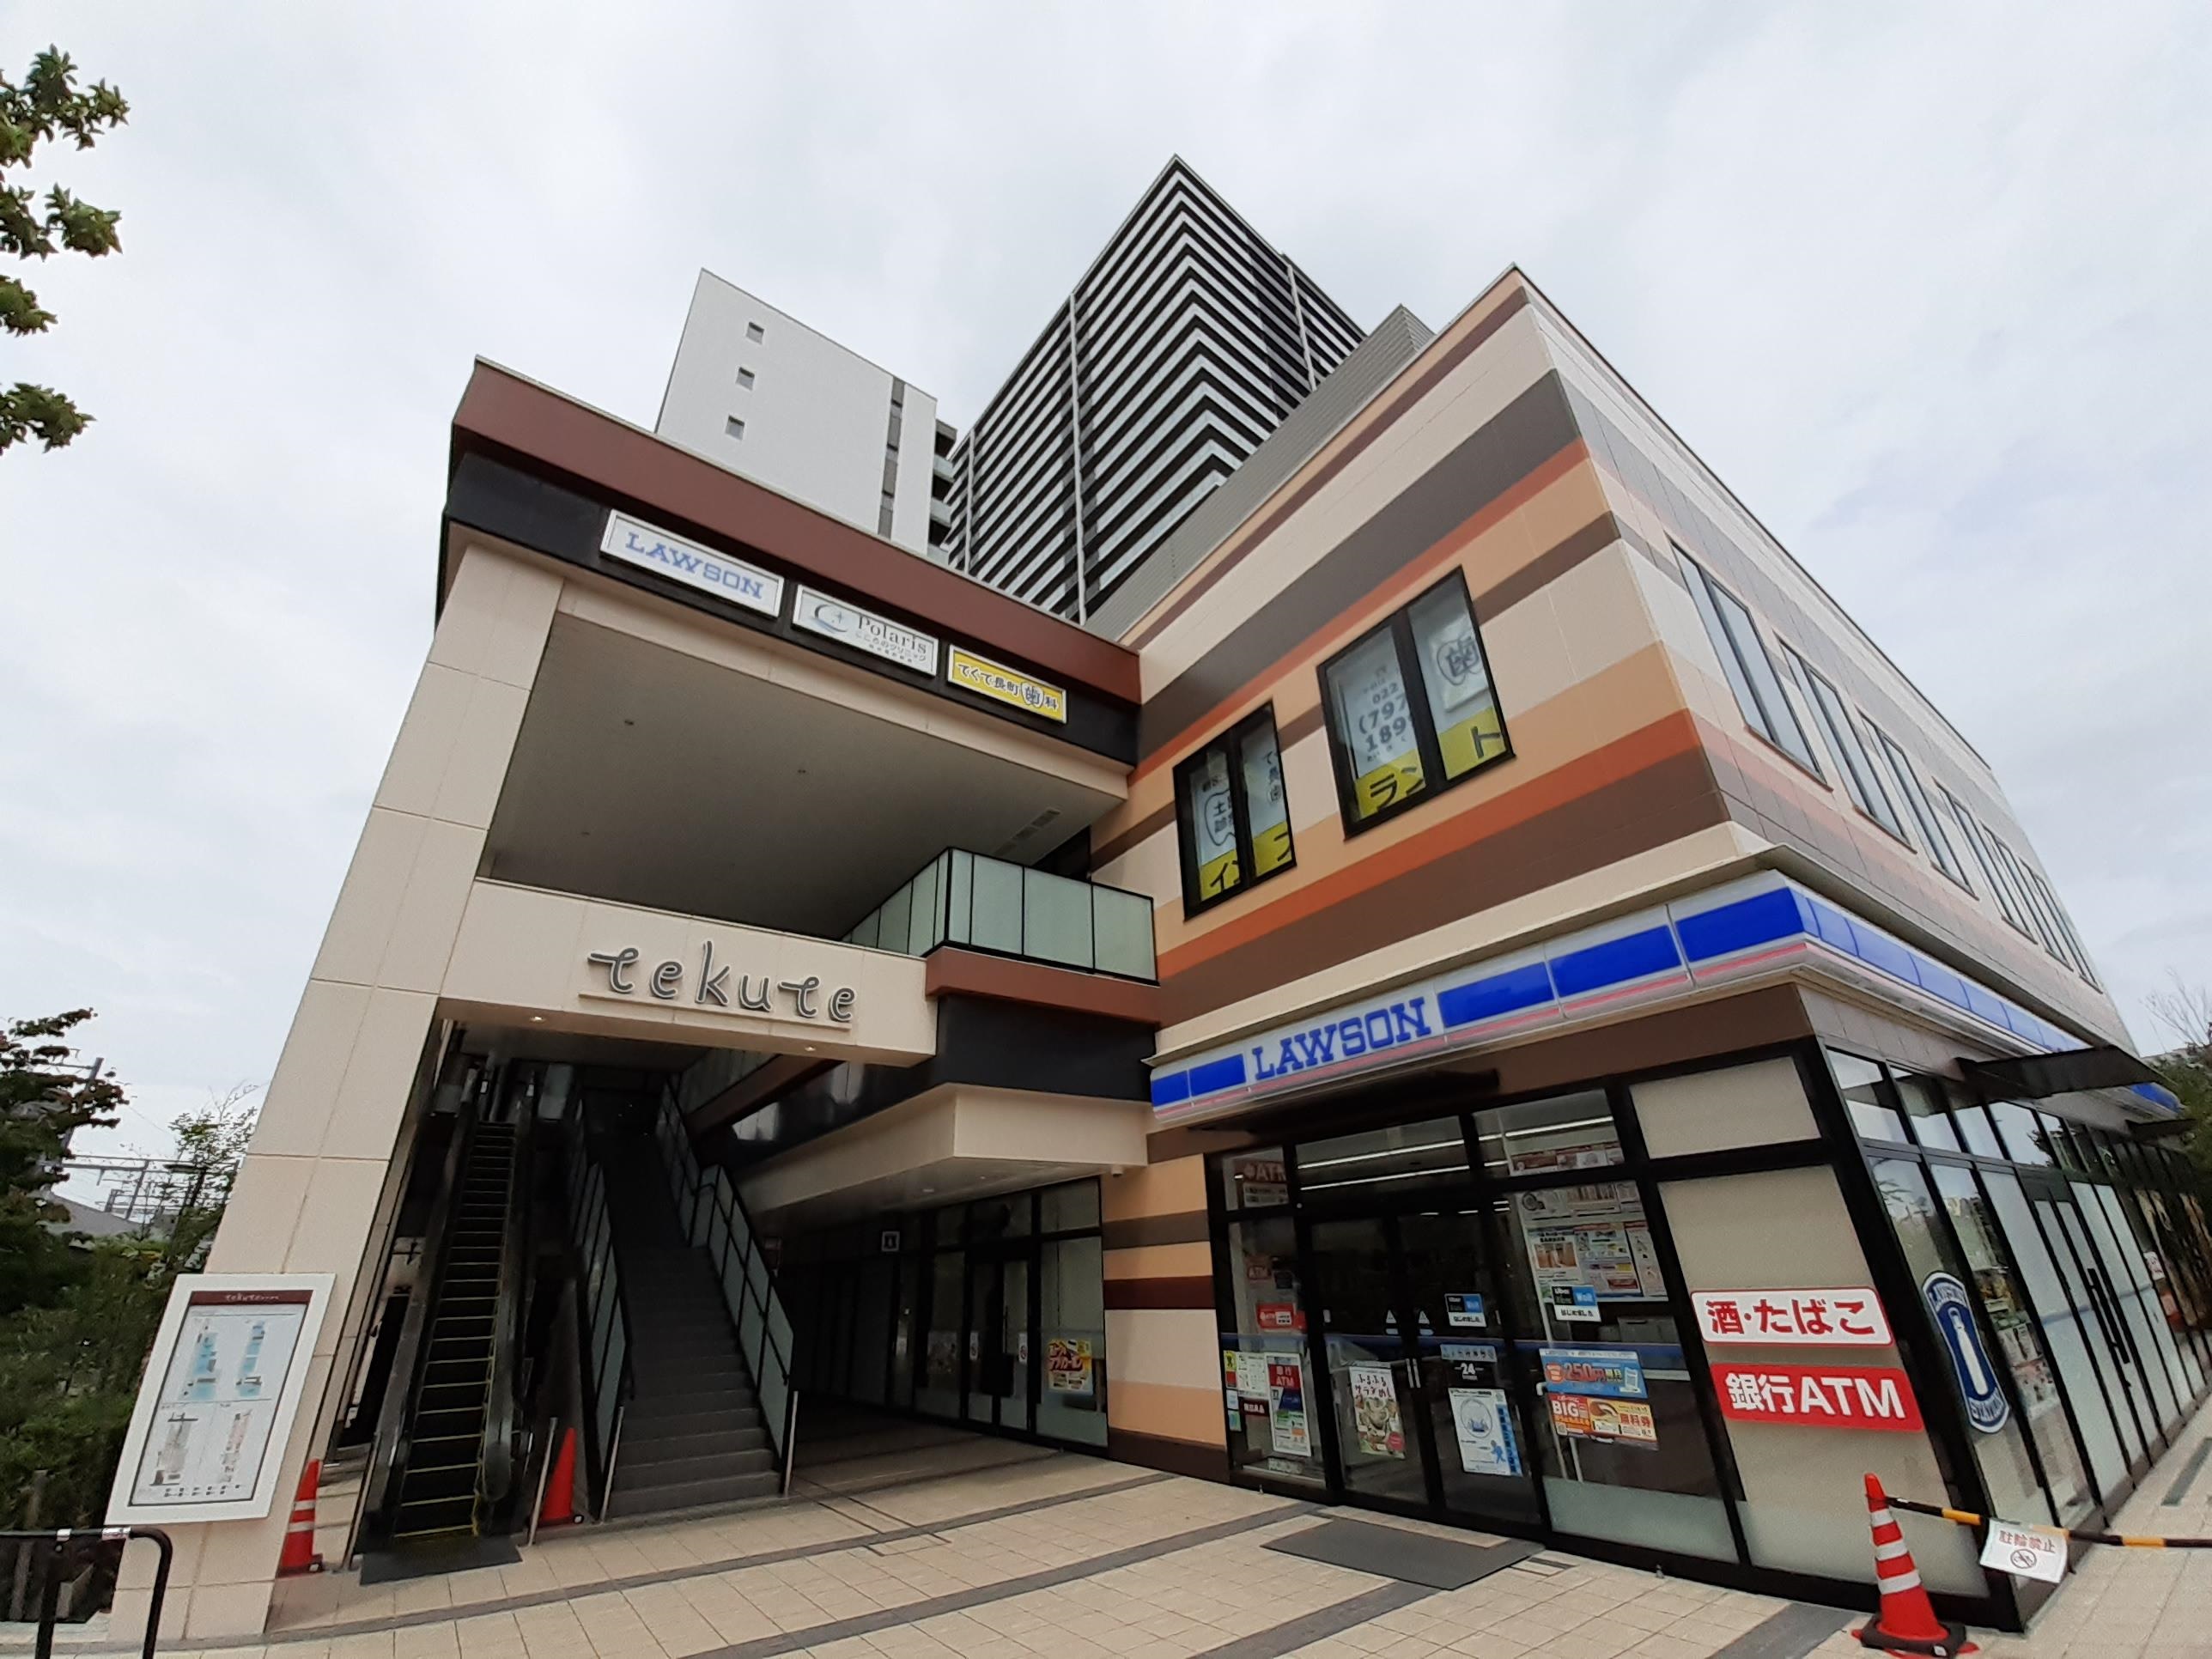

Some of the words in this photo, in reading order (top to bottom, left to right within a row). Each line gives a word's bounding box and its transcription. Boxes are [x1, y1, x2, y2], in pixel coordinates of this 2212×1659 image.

[624, 531, 764, 599] LAWSON
[858, 614, 927, 655] Polaris
[1372, 683, 1400, 704] 022
[586, 939, 857, 1023] tekute
[1252, 996, 1432, 1080] LAWSON
[1705, 1298, 1877, 1336] 酒・たばこ
[1552, 1401, 1579, 1418] BIG
[1724, 1372, 1907, 1420] 銀行ATM
